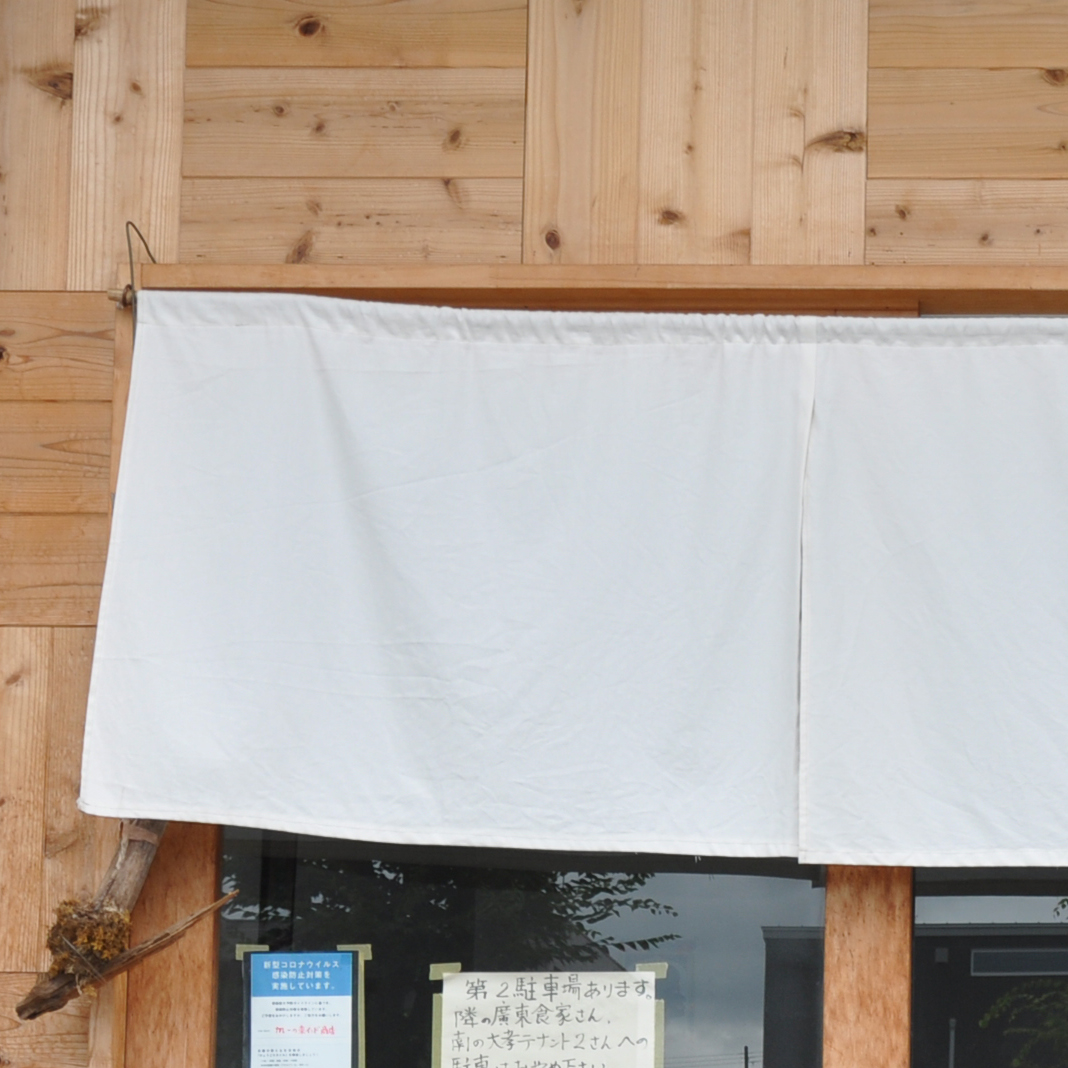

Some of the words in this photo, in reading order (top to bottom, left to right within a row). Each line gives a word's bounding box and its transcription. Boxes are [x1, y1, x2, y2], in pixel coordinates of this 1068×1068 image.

[263, 961, 340, 969] 新型コロナウイルス
[272, 971, 331, 979] 感染防止対策を
